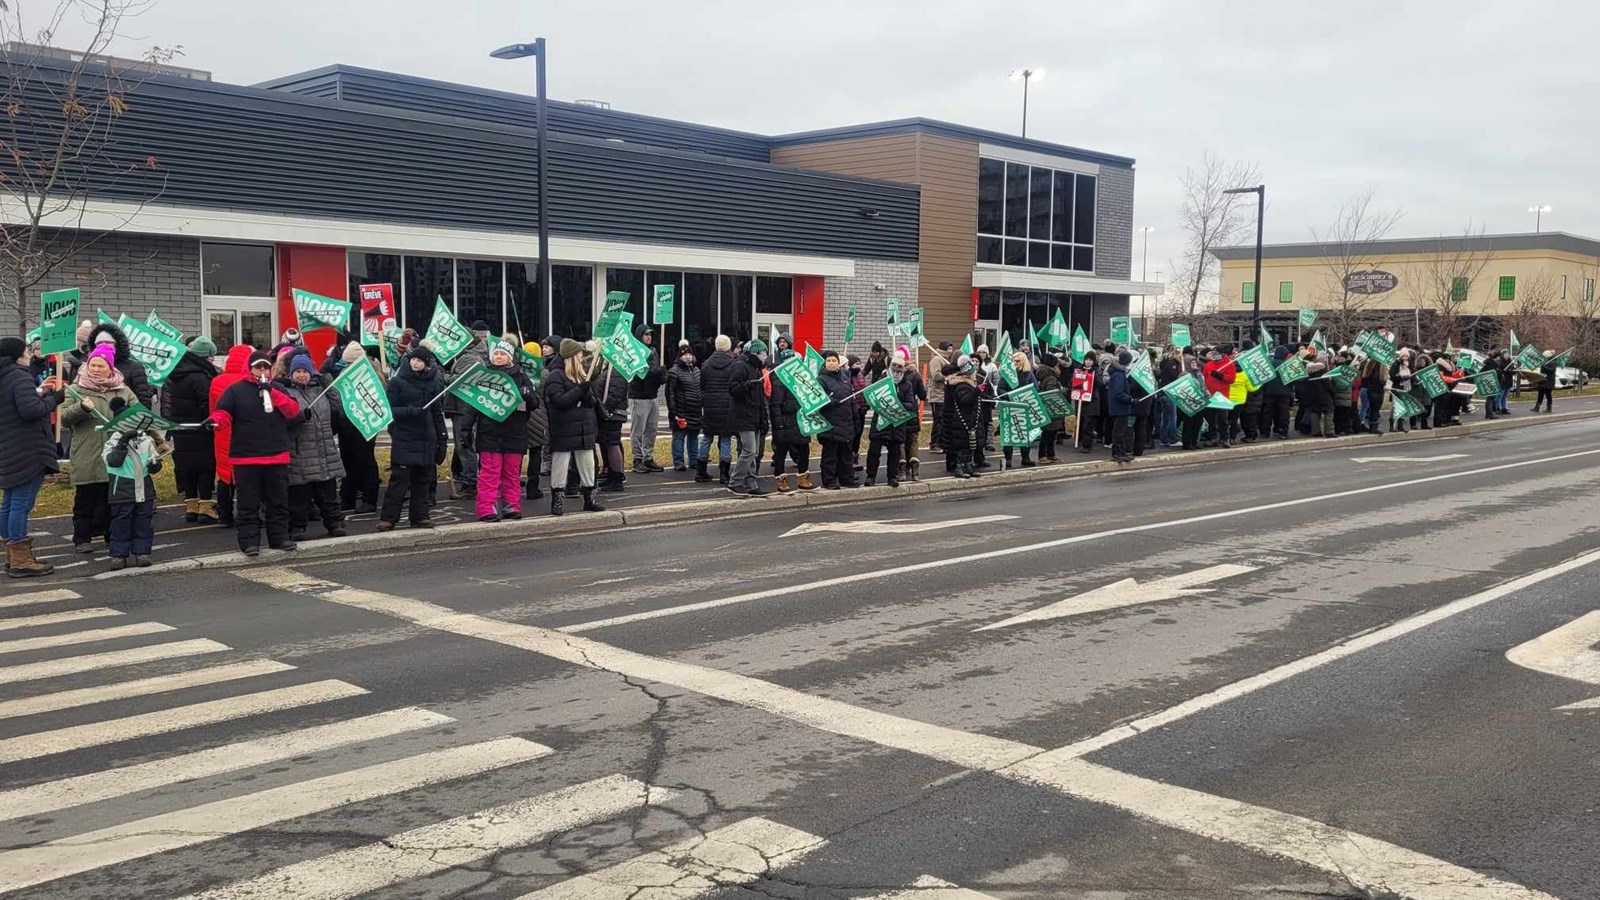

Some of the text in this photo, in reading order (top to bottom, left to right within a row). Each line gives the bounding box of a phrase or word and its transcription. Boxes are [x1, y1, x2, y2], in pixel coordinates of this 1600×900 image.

[44, 299, 76, 320] NOUS
[296, 295, 346, 326] NOUS
[122, 324, 178, 371] NOUS
[497, 340, 514, 355] NOU
[785, 361, 828, 405] NOUS
[1247, 352, 1274, 381] NOUS
[347, 363, 388, 428] NOUS
[464, 369, 516, 407] NOUS
[1010, 407, 1028, 444] NOUS
[1018, 390, 1047, 426] NOUS
